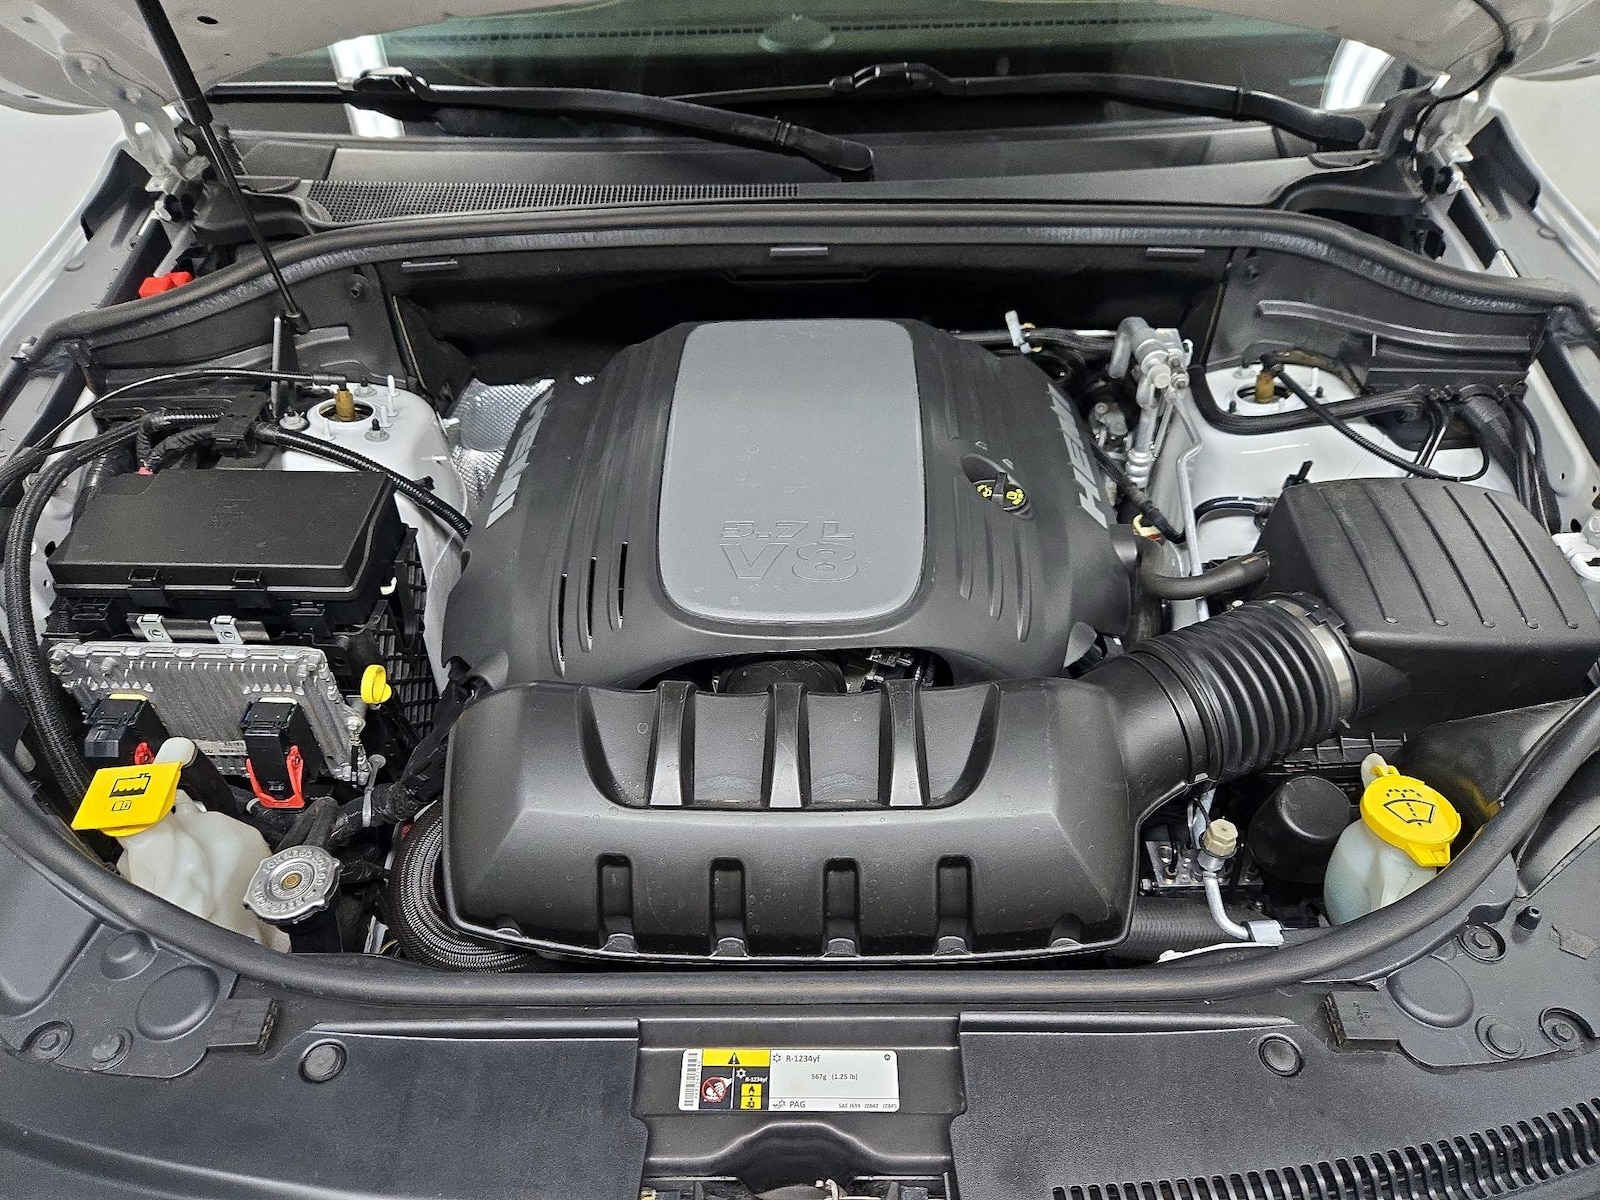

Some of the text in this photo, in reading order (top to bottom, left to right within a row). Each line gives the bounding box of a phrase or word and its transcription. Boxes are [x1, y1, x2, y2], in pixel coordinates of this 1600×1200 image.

[1047, 383, 1108, 529] HEMI
[718, 541, 859, 583] V8
[785, 1054, 821, 1064] R-1234yf
[811, 1073, 858, 1081] 567g (1.25 lb)
